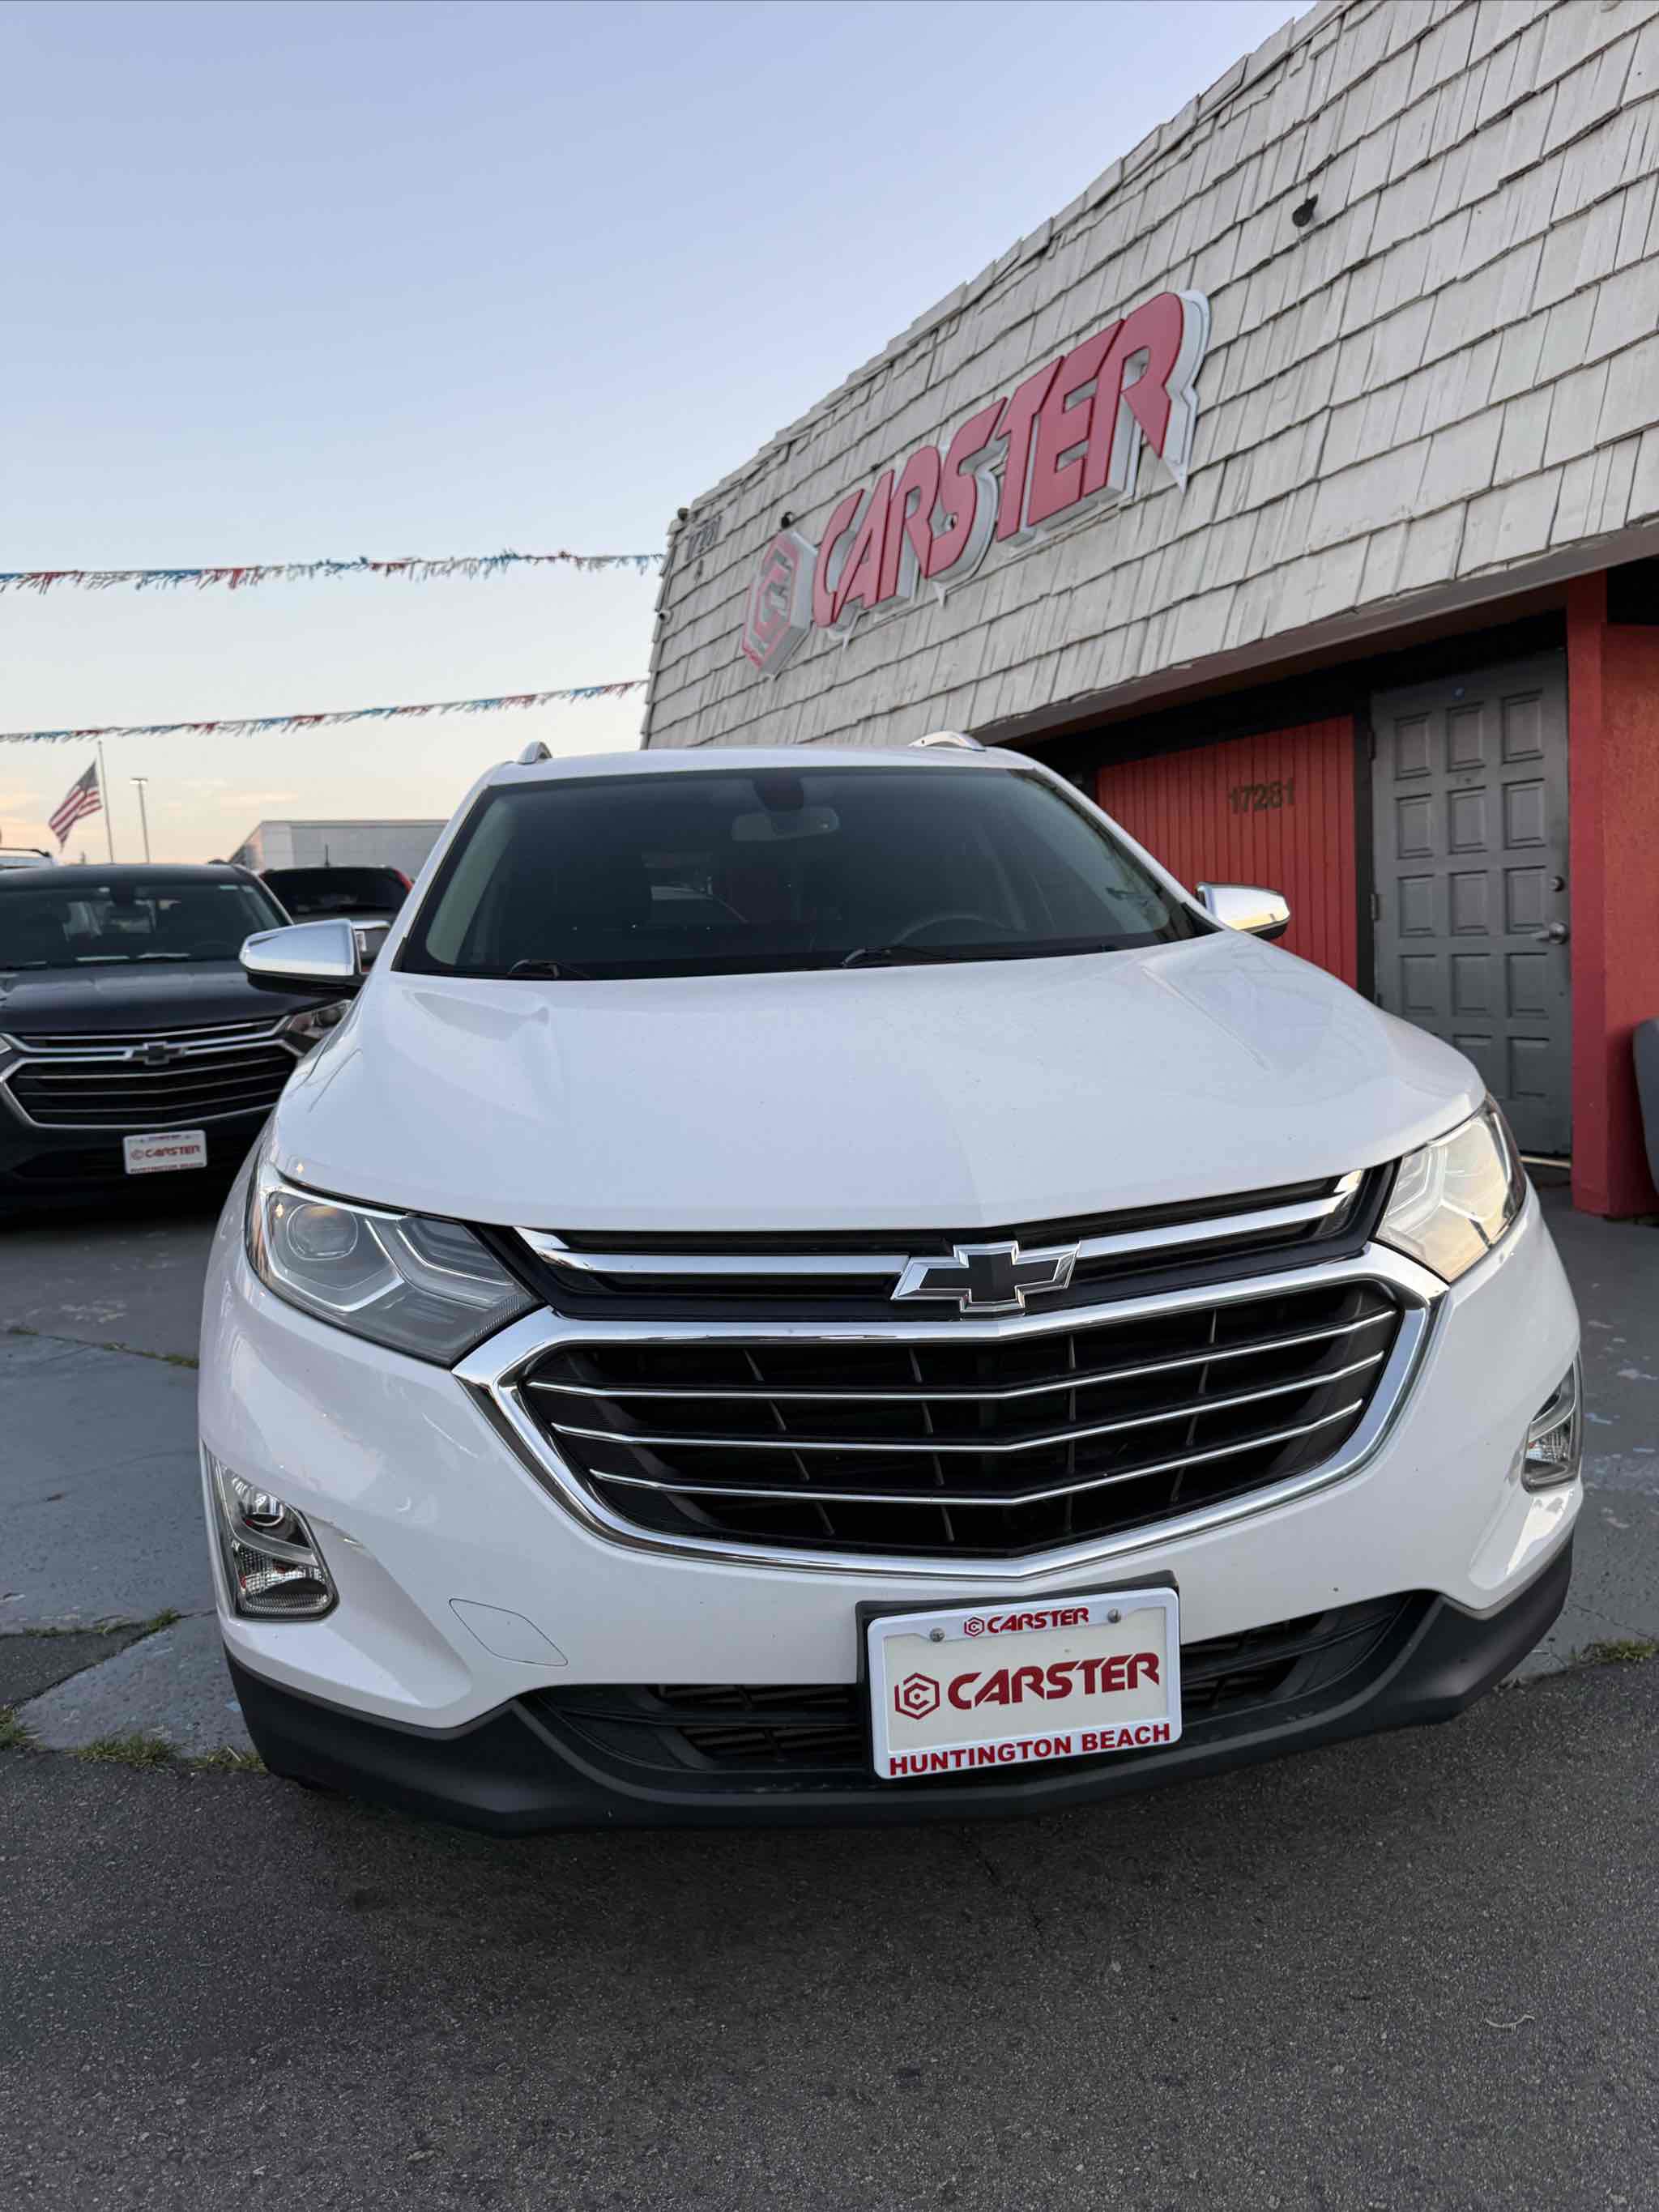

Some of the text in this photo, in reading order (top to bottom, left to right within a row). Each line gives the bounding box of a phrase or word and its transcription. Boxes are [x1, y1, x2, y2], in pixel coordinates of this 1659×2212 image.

[812, 292, 1185, 629] CARSTER
[145, 1144, 201, 1157] CARSTER
[987, 1607, 1089, 1634] CARSTER
[948, 1652, 1160, 1711] CARSTER
[889, 1723, 1171, 1776] HUNTINGTON BEACH
